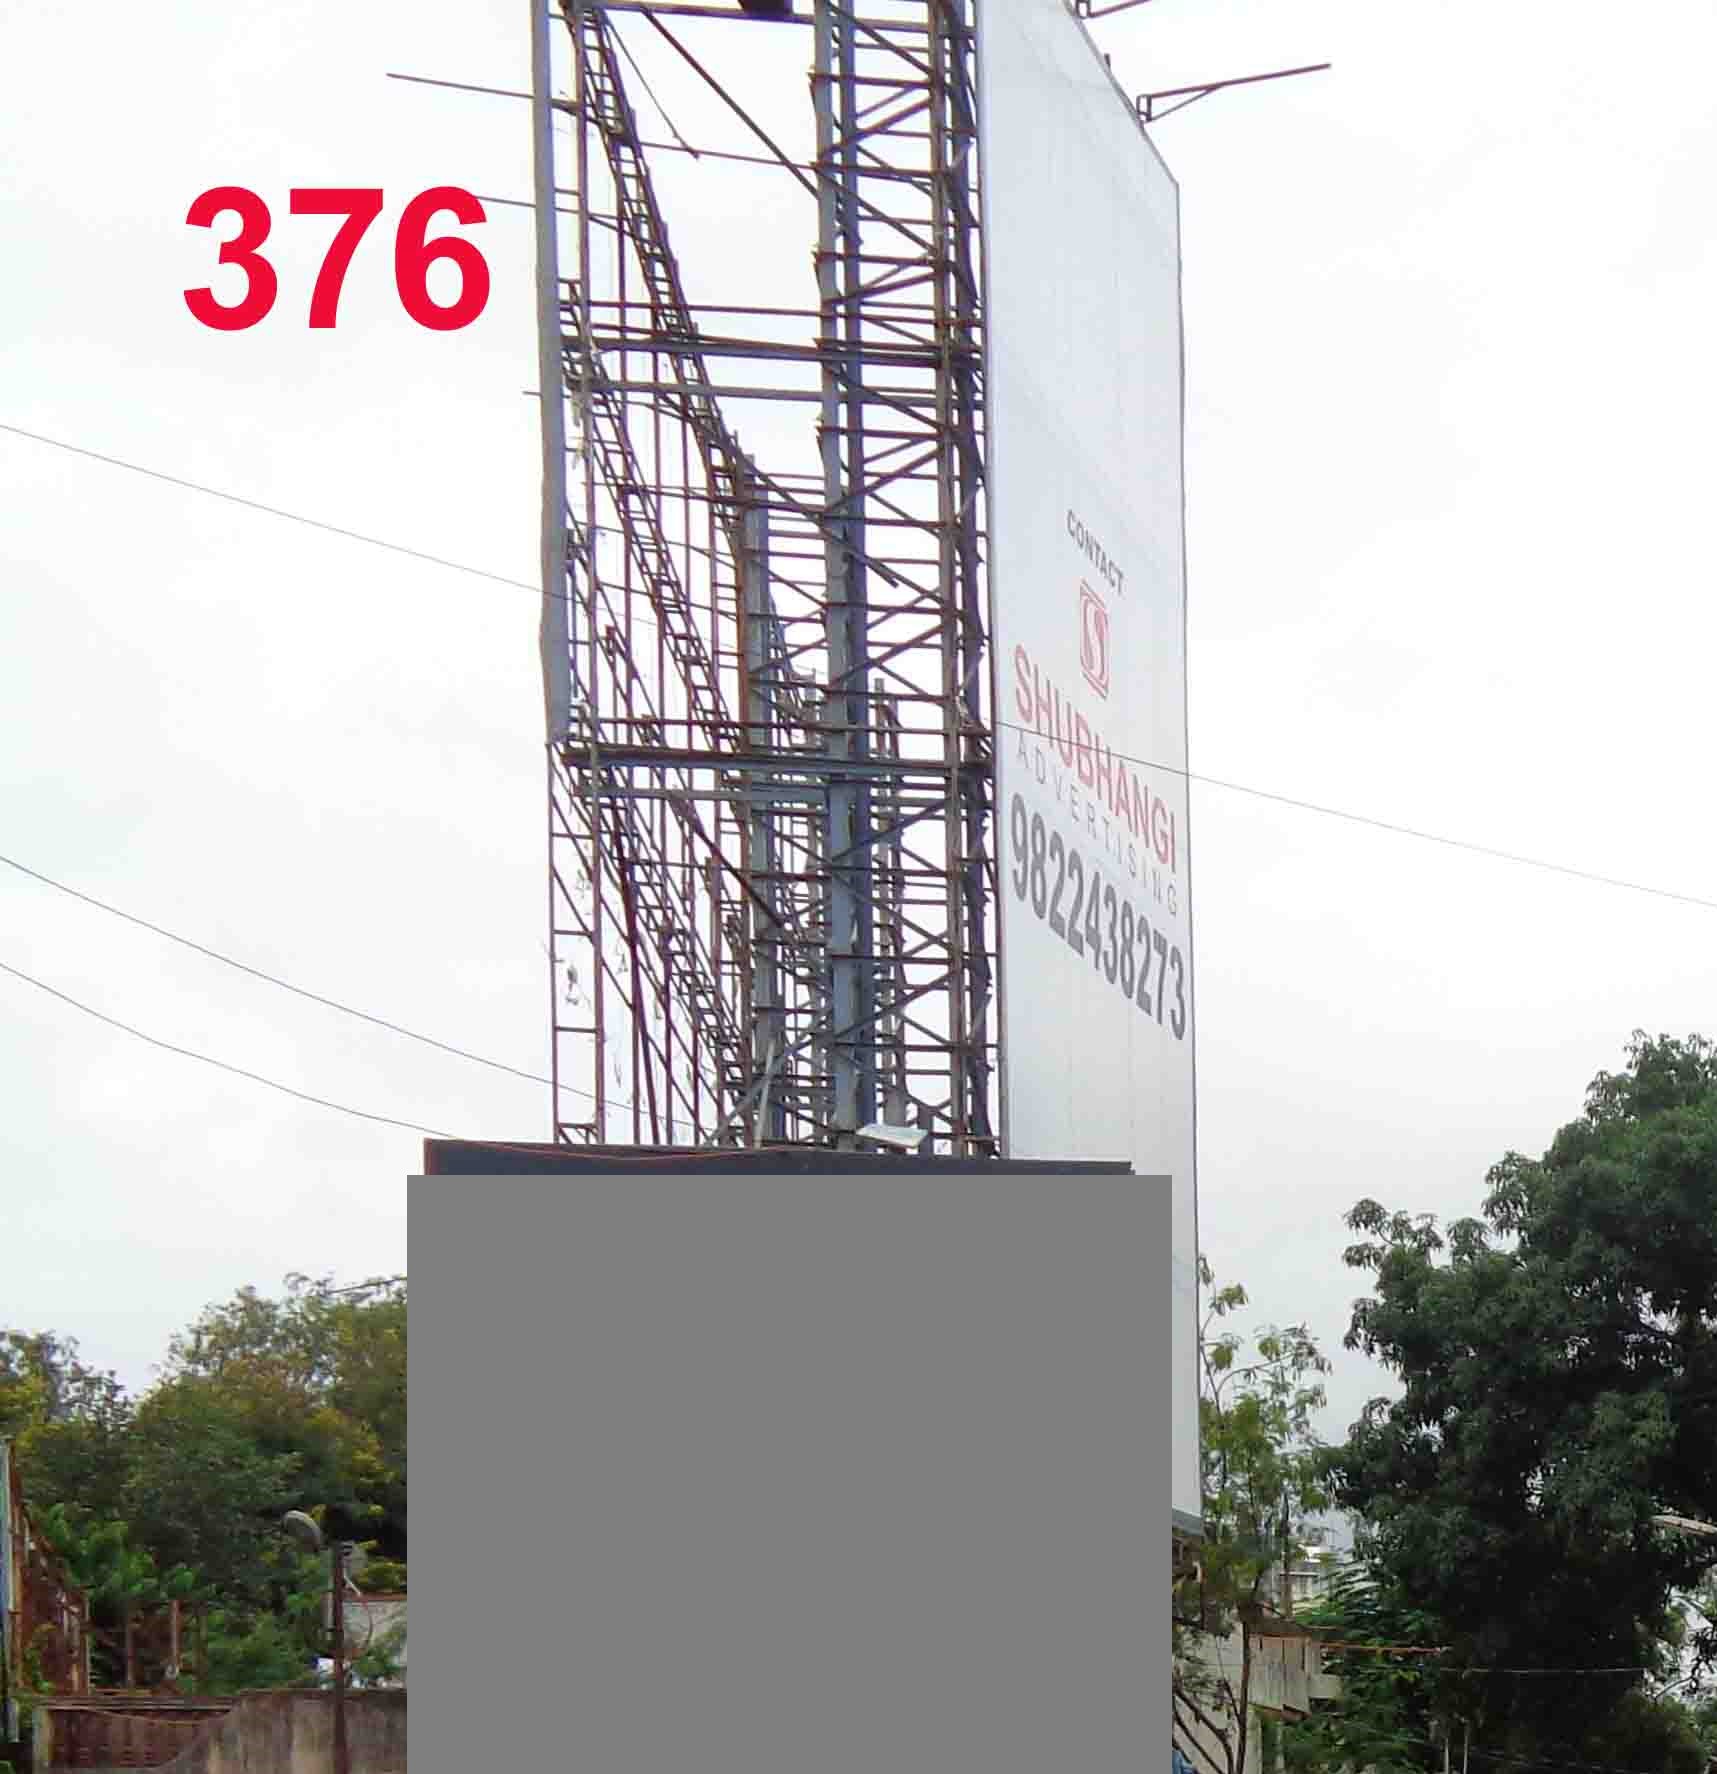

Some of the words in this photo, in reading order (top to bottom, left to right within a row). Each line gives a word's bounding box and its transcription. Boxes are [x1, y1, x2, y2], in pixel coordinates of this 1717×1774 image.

[1066, 509, 1124, 597] CONTACT
[1013, 644, 1177, 873] SHUBHANGI
[1011, 793, 1186, 1041] 9822438273
